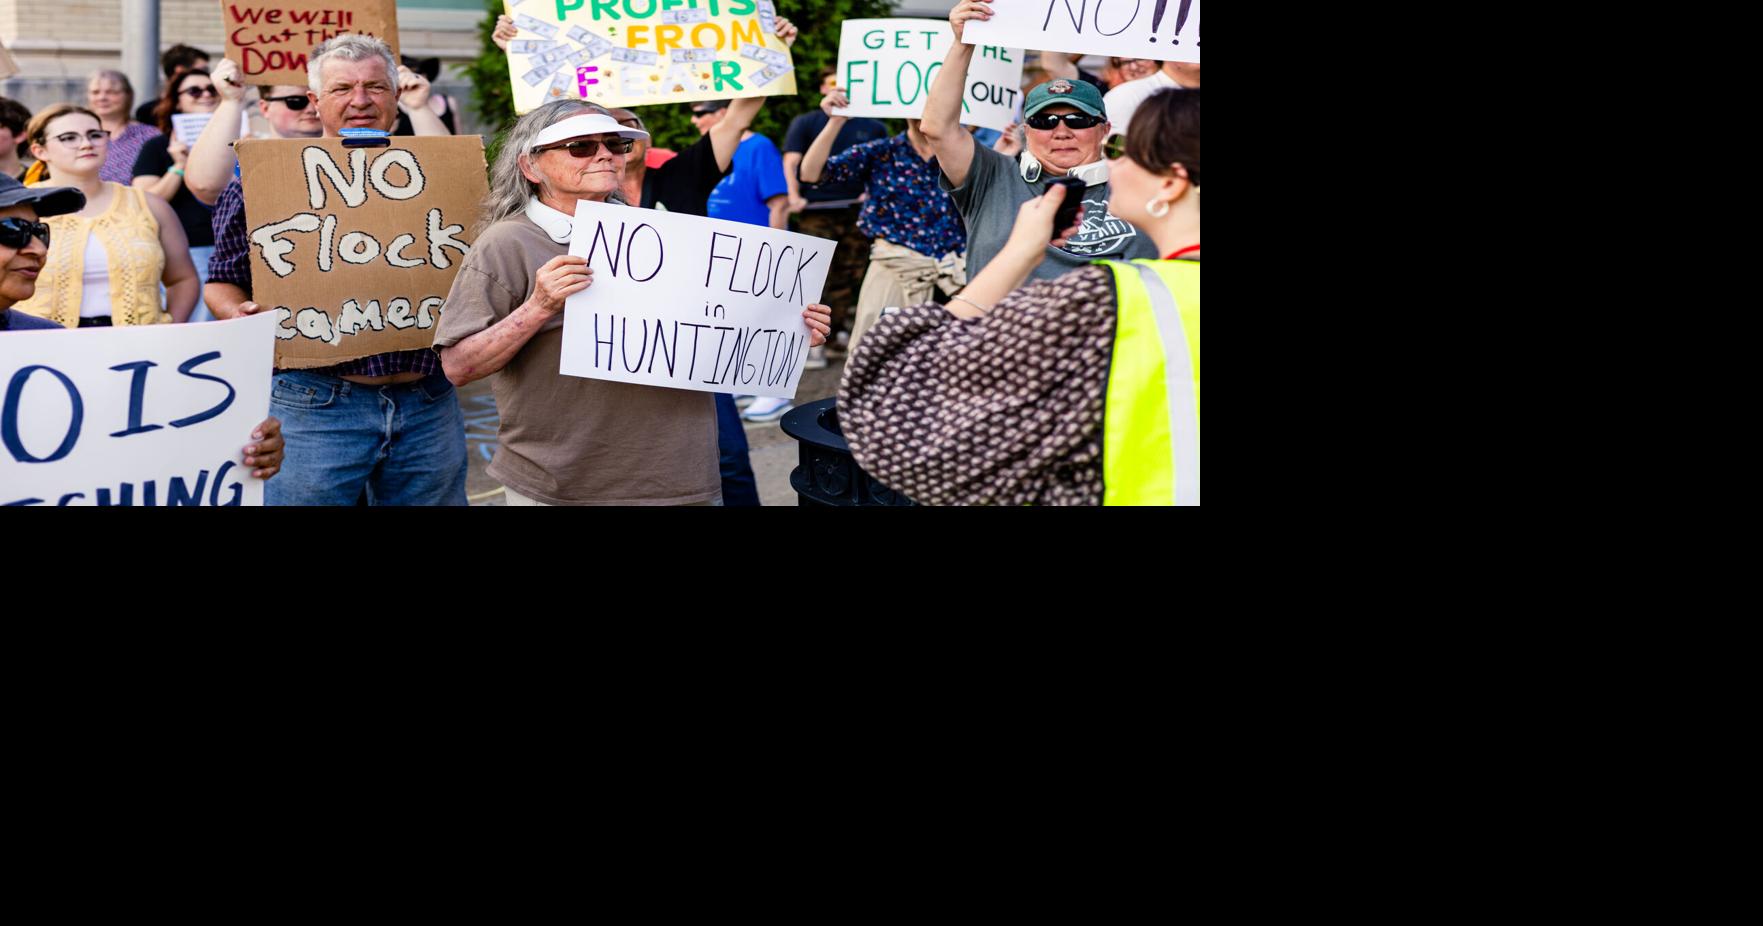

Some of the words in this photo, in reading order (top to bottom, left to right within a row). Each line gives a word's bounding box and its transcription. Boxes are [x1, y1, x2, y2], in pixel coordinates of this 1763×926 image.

[230, 5, 283, 25] We
[626, 19, 767, 56] FROM
[863, 30, 939, 51] GET
[982, 45, 1013, 63] HE
[576, 60, 744, 98] FEAR
[846, 60, 970, 113] FLOC
[971, 81, 1018, 109] OUT
[301, 145, 426, 210] NO
[250, 208, 471, 278] Flock
[586, 221, 664, 282] NO
[705, 231, 819, 306] FLOCK
[705, 301, 726, 320] in
[594, 313, 804, 388] HUNTINGTON
[109, 351, 237, 437] IS
